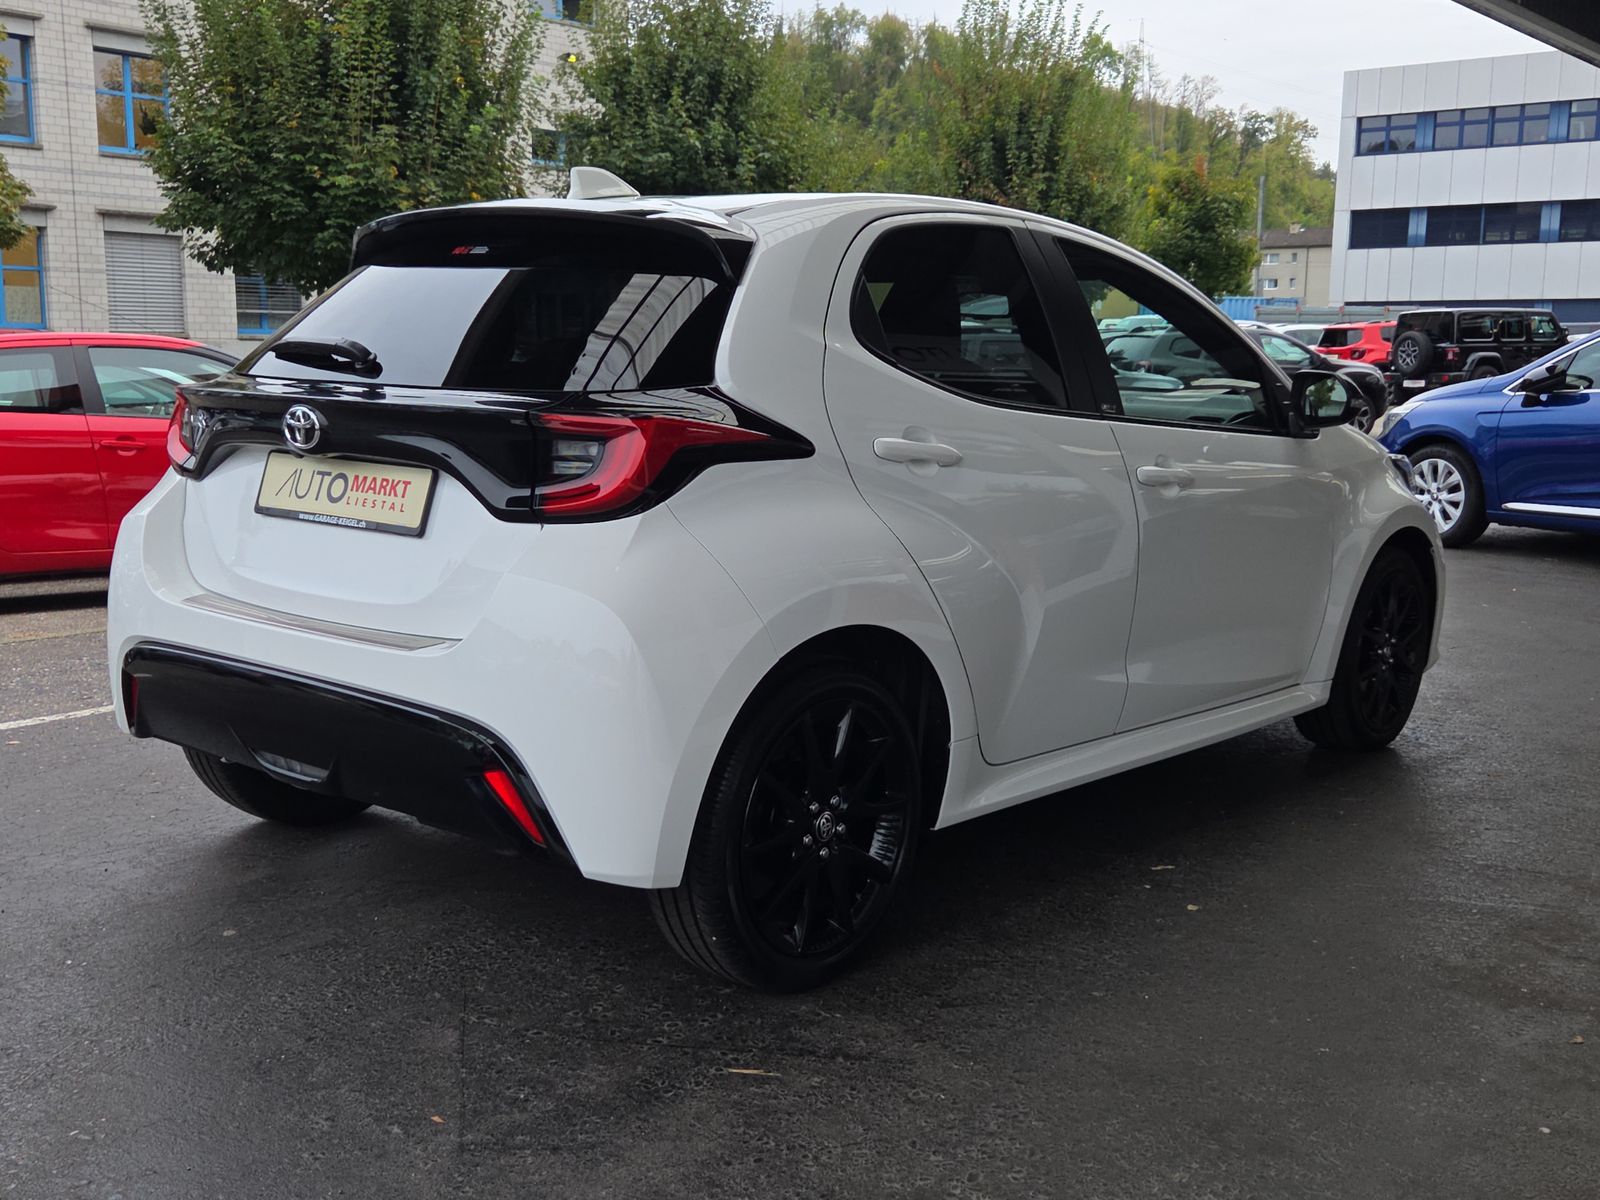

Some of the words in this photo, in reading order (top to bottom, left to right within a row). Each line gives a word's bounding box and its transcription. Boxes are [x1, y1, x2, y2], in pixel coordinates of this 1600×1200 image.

[275, 468, 349, 504] AUTO
[350, 474, 412, 499] MARKT
[346, 496, 405, 513] LIESTAL
